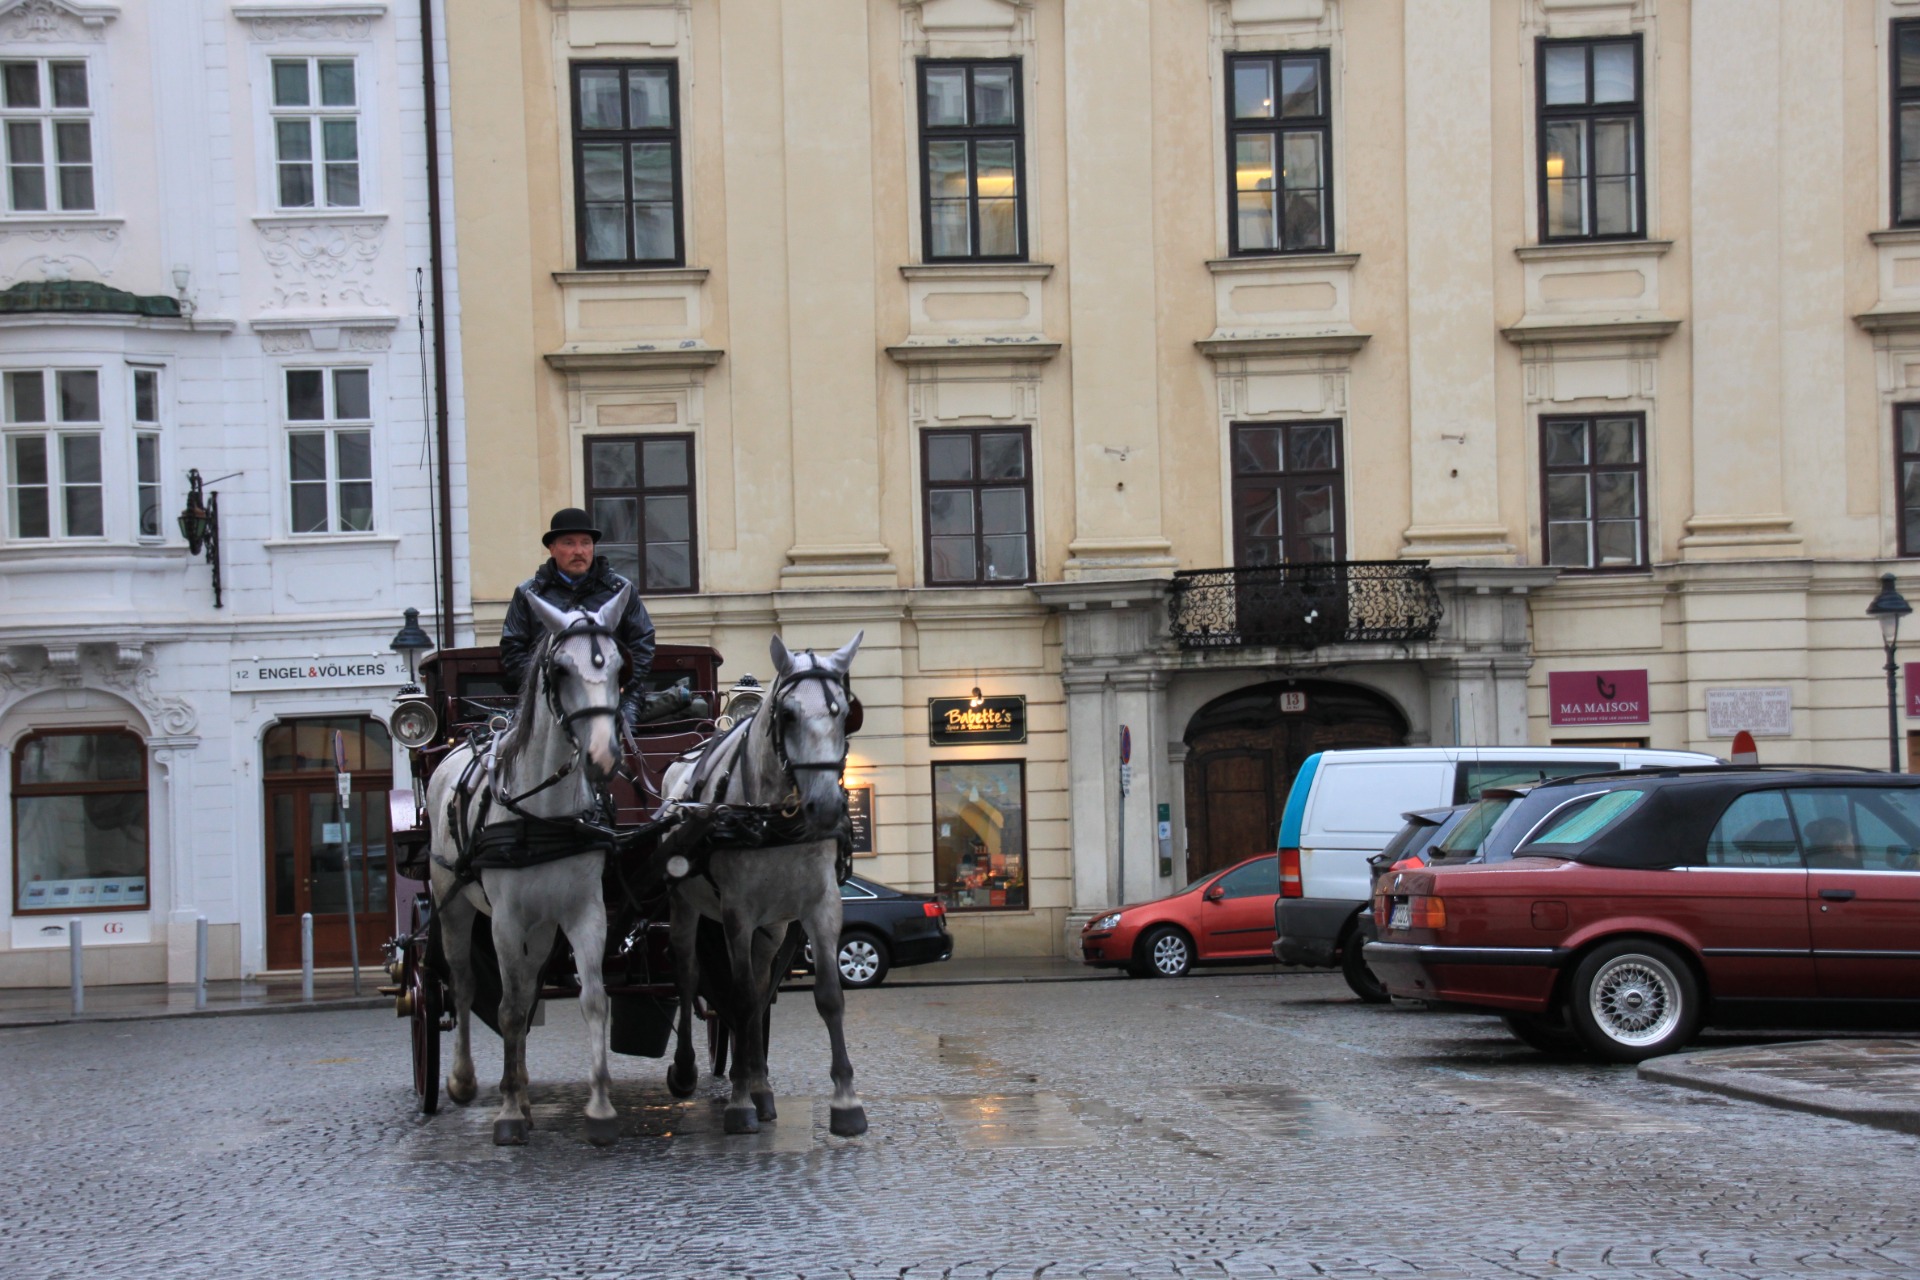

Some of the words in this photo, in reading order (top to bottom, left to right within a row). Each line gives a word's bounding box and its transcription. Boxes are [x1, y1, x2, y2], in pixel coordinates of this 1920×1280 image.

[236, 670, 249, 679] 12
[1286, 693, 1299, 706] 13
[1561, 703, 1581, 713] MA
[1585, 702, 1638, 712] MAISON
[944, 708, 1011, 724] Babette's
